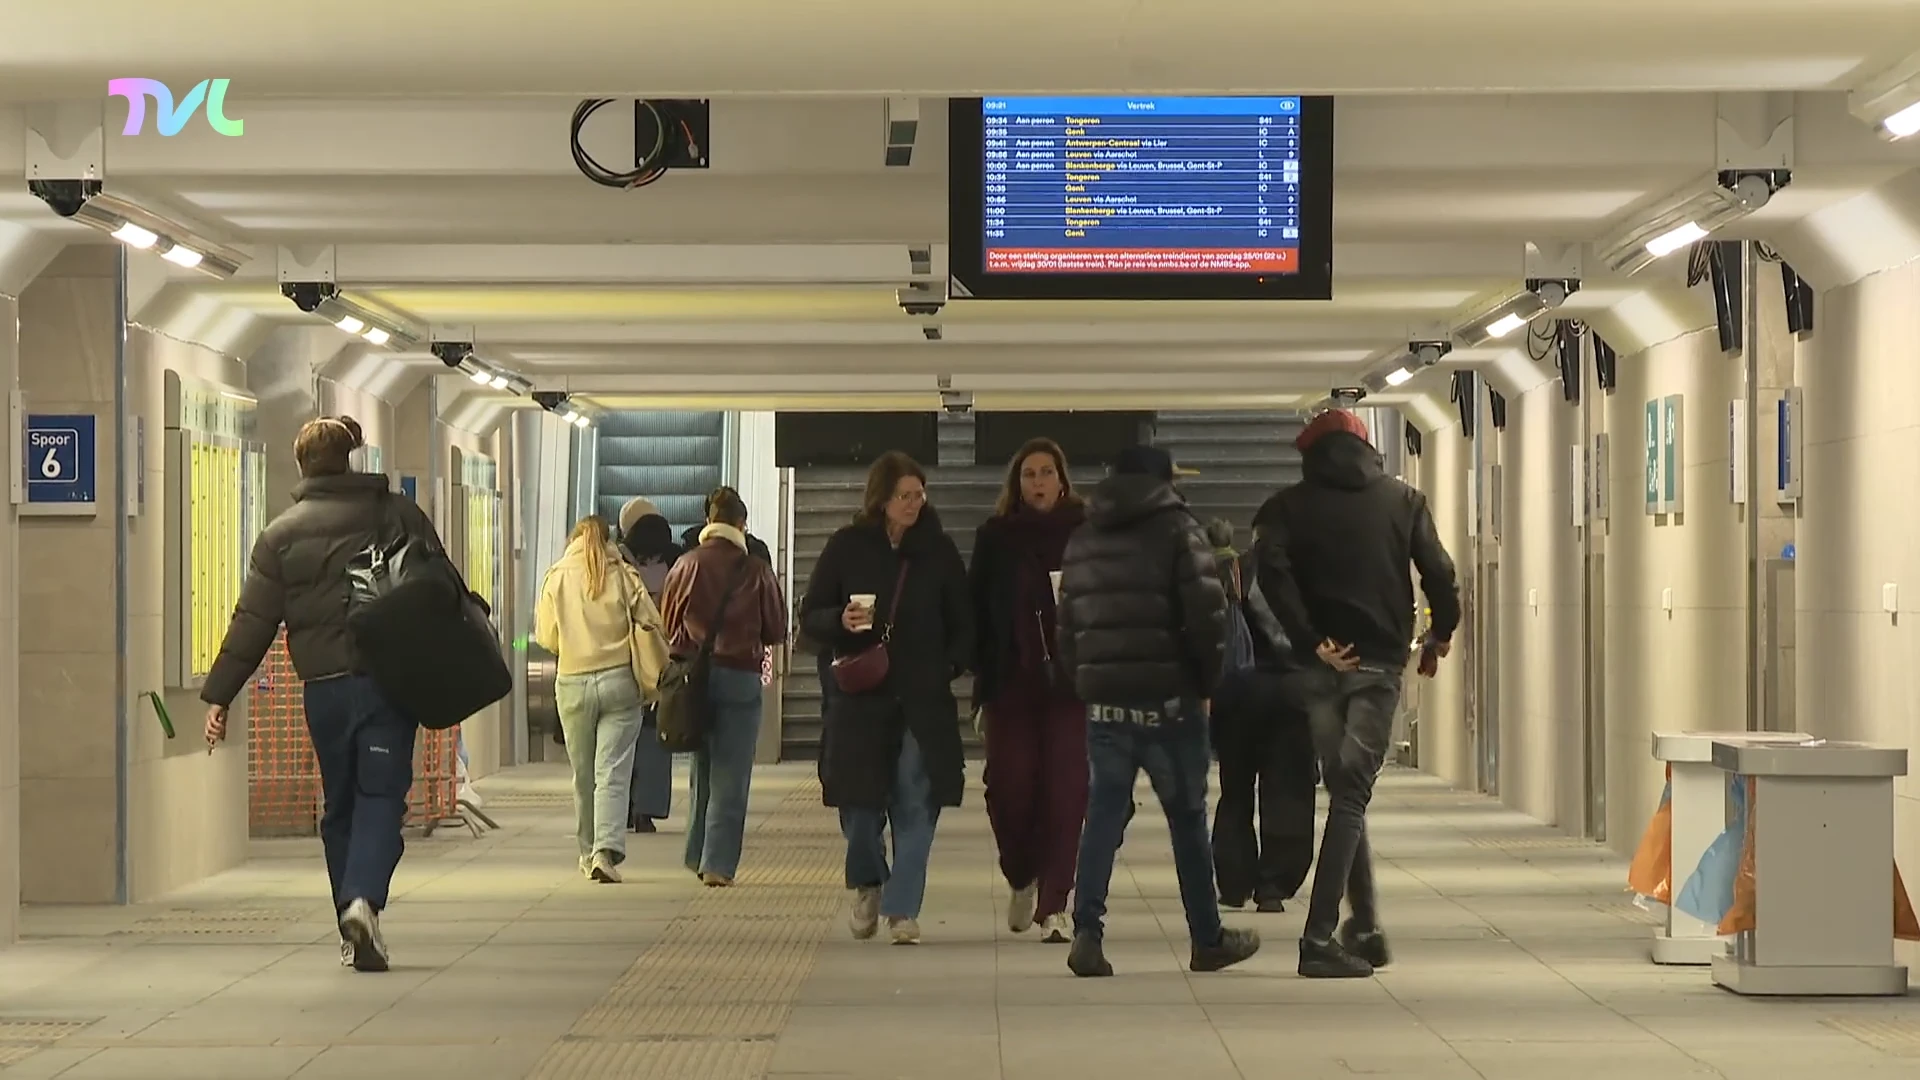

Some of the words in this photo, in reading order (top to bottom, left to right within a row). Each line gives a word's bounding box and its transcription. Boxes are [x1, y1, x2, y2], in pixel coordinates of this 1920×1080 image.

[1127, 101, 1155, 110] Vertrek
[1065, 116, 1100, 125] Tongeren
[1065, 127, 1085, 136] Genk
[1259, 127, 1268, 136] IC
[1288, 127, 1295, 136] A
[986, 139, 1006, 147] 09:41
[1016, 139, 1030, 147] Aan
[1031, 140, 1054, 148] perron
[1065, 139, 1140, 148] Antwerpen-Centraal
[1141, 139, 1152, 147] via
[1153, 139, 1167, 147] Lier
[1259, 138, 1268, 147] IC
[1105, 150, 1137, 158] Aarschot
[1259, 150, 1264, 158] L
[986, 162, 1007, 170] 10:00
[1016, 162, 1030, 170] Aan
[1031, 163, 1054, 171] perron
[1065, 161, 1116, 171] Blankenberge
[1117, 162, 1128, 170] via
[1259, 161, 1268, 170] IC
[1065, 173, 1100, 182] Tongeren
[1065, 184, 1085, 192] Genk
[1259, 184, 1268, 192] IC
[1288, 184, 1295, 192] A
[1105, 195, 1137, 203] Aarschot
[1259, 195, 1264, 203] L
[986, 207, 1005, 215] 11:00
[1065, 206, 1116, 216] Blankenberge
[1117, 207, 1128, 215] via
[1259, 206, 1268, 215] IC
[1065, 218, 1100, 227] Tongeren
[1065, 229, 1085, 237] Genk
[1259, 229, 1268, 237] IC
[990, 252, 1007, 260] Door
[1009, 252, 1022, 260] een
[1023, 251, 1049, 261] staking
[1050, 251, 1092, 261] organiseren
[1093, 252, 1105, 260] we
[1105, 252, 1119, 260] een
[1120, 251, 1162, 260] alternatieve
[1163, 251, 1200, 260] treindienst
[1216, 252, 1242, 262] zondag
[1011, 260, 1036, 270] vrijdag
[1037, 260, 1057, 269] 30/01
[1058, 260, 1084, 269] (laatste
[1108, 260, 1123, 269] Plan
[1124, 260, 1132, 270] je
[1133, 260, 1146, 269] reis
[1147, 260, 1158, 269] via
[1159, 260, 1190, 269] nmbs.be
[1191, 260, 1199, 269] of
[1200, 260, 1209, 269] de
[31, 432, 71, 448] Spoor
[42, 448, 61, 478] 6
